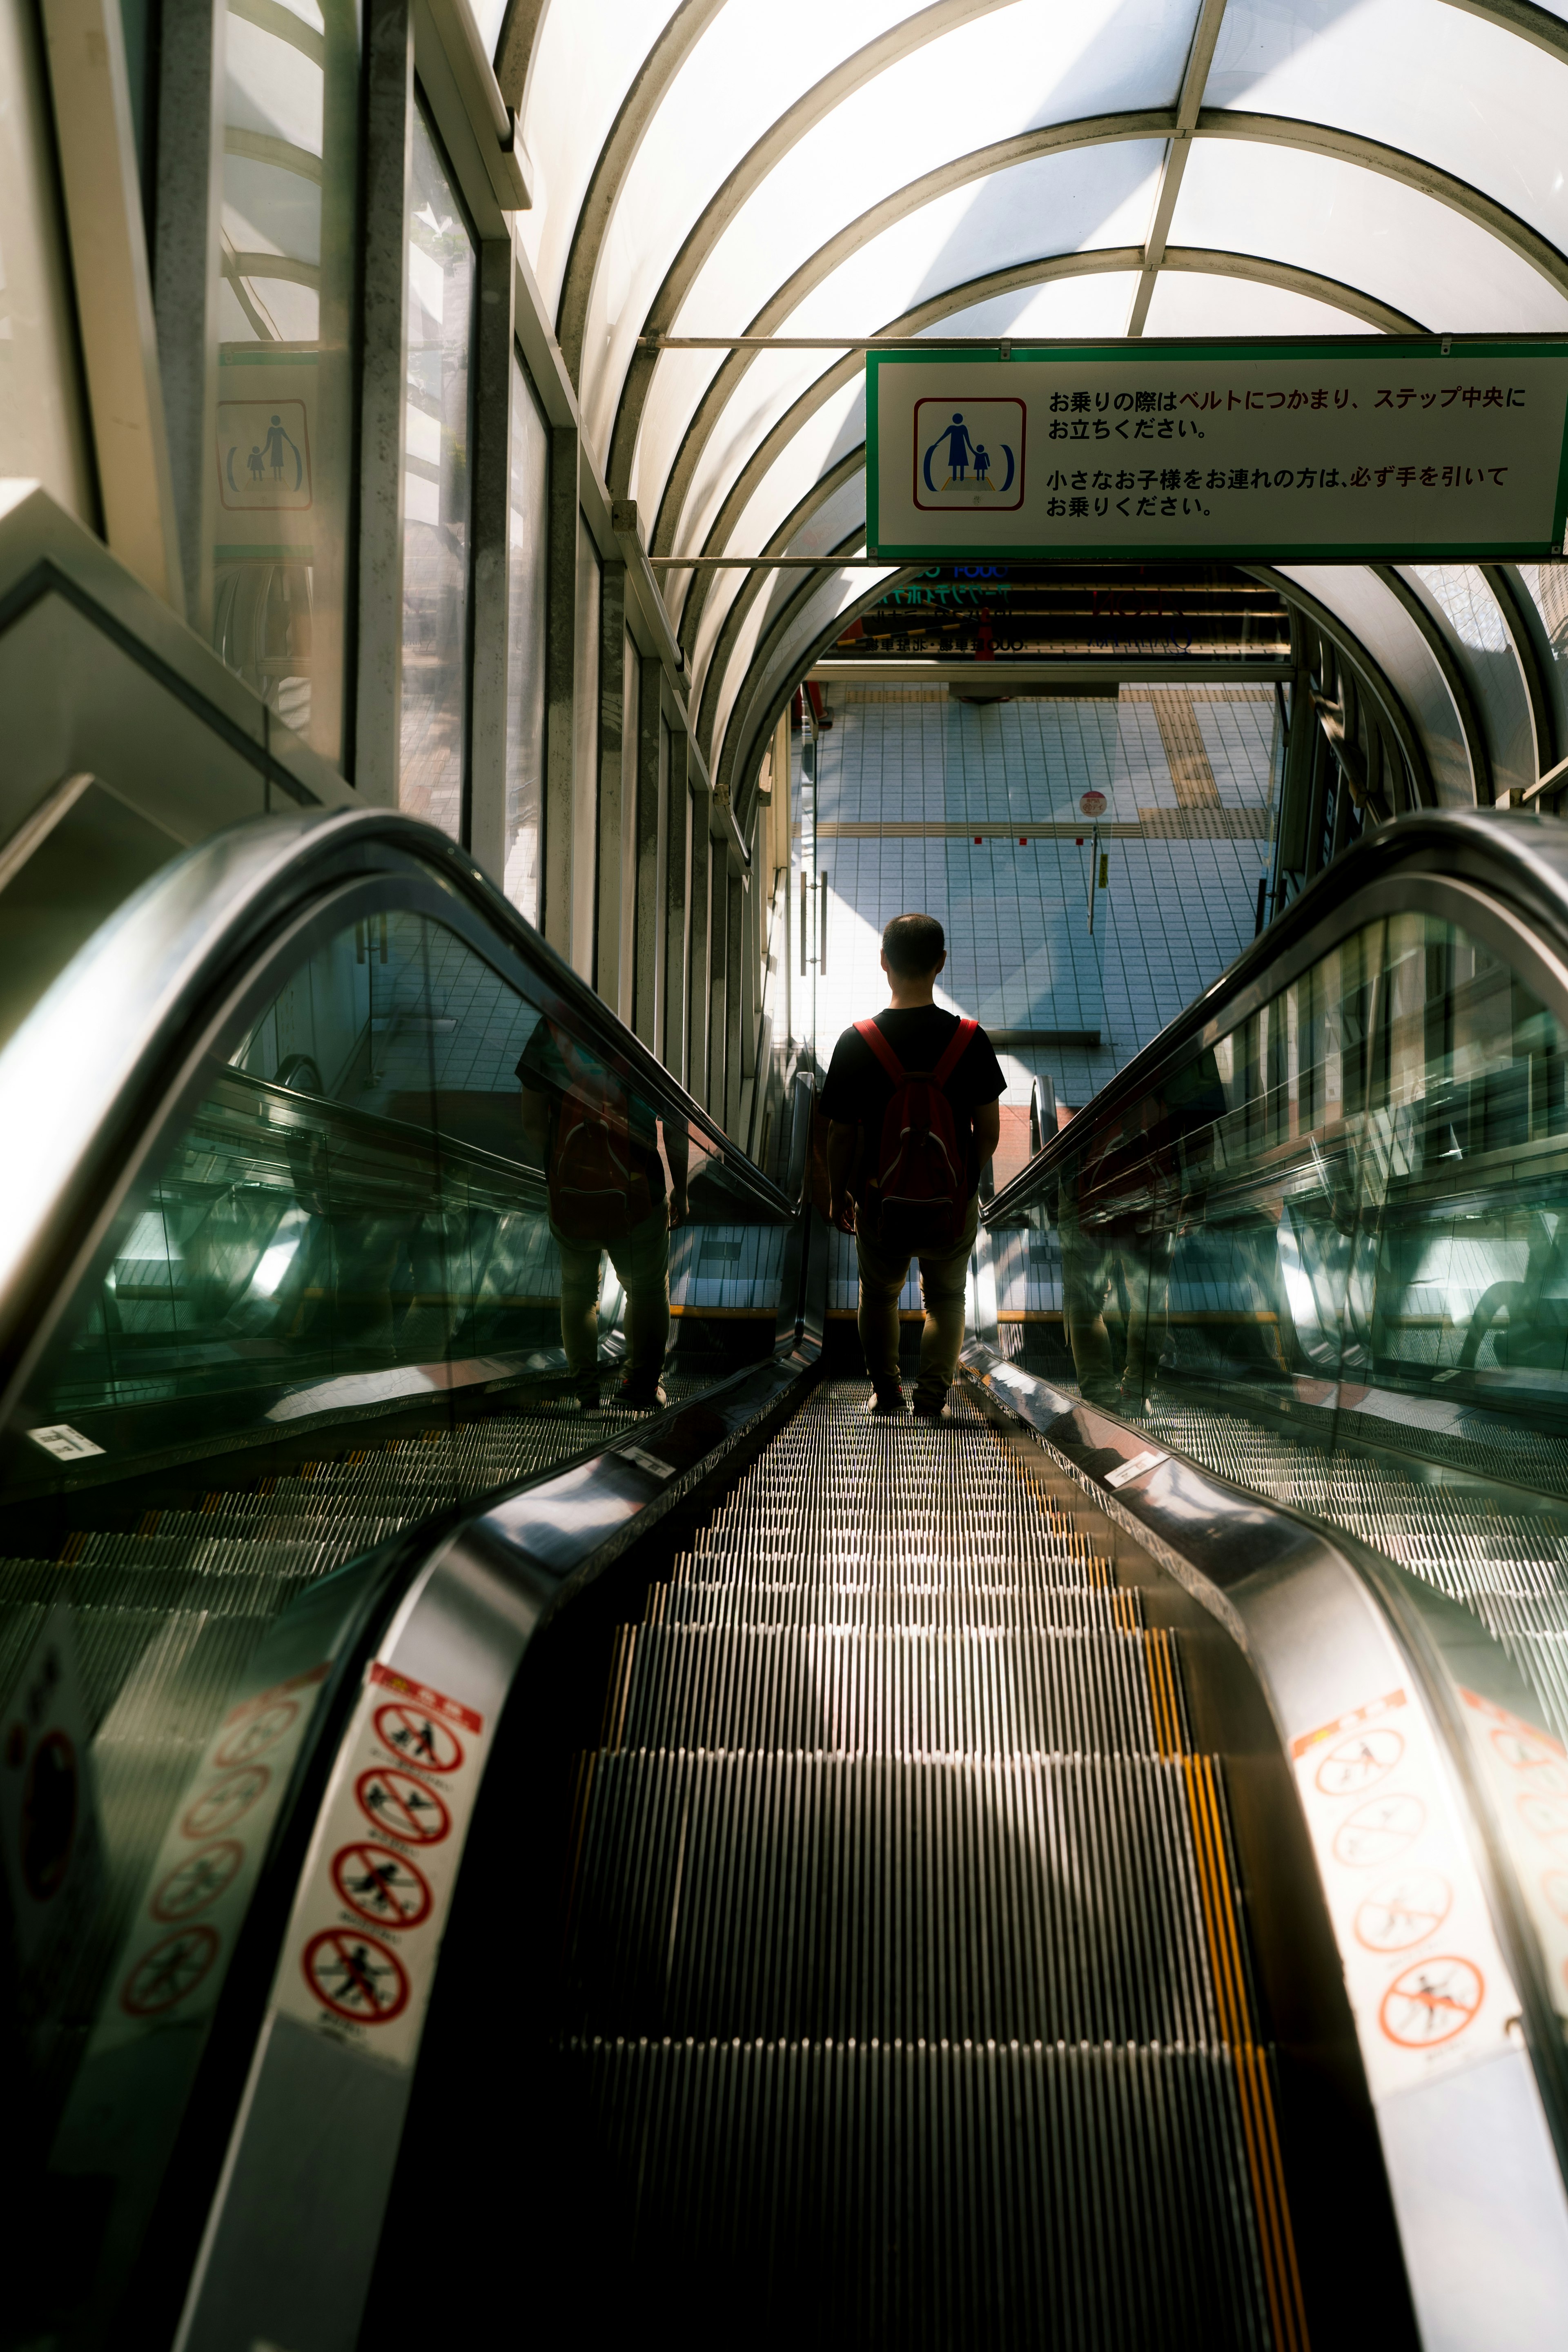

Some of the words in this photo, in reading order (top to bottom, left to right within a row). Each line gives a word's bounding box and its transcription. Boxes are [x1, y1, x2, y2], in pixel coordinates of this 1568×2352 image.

[1049, 385, 1526, 413] お乗りの際はベルトにつかまり、ステップ中央に
[1048, 417, 1205, 440] お立ちください。
[1046, 465, 1508, 491] 小さなお子様をお連れの方は、必ず手を引いて
[1047, 495, 1210, 518] お乗りください。
